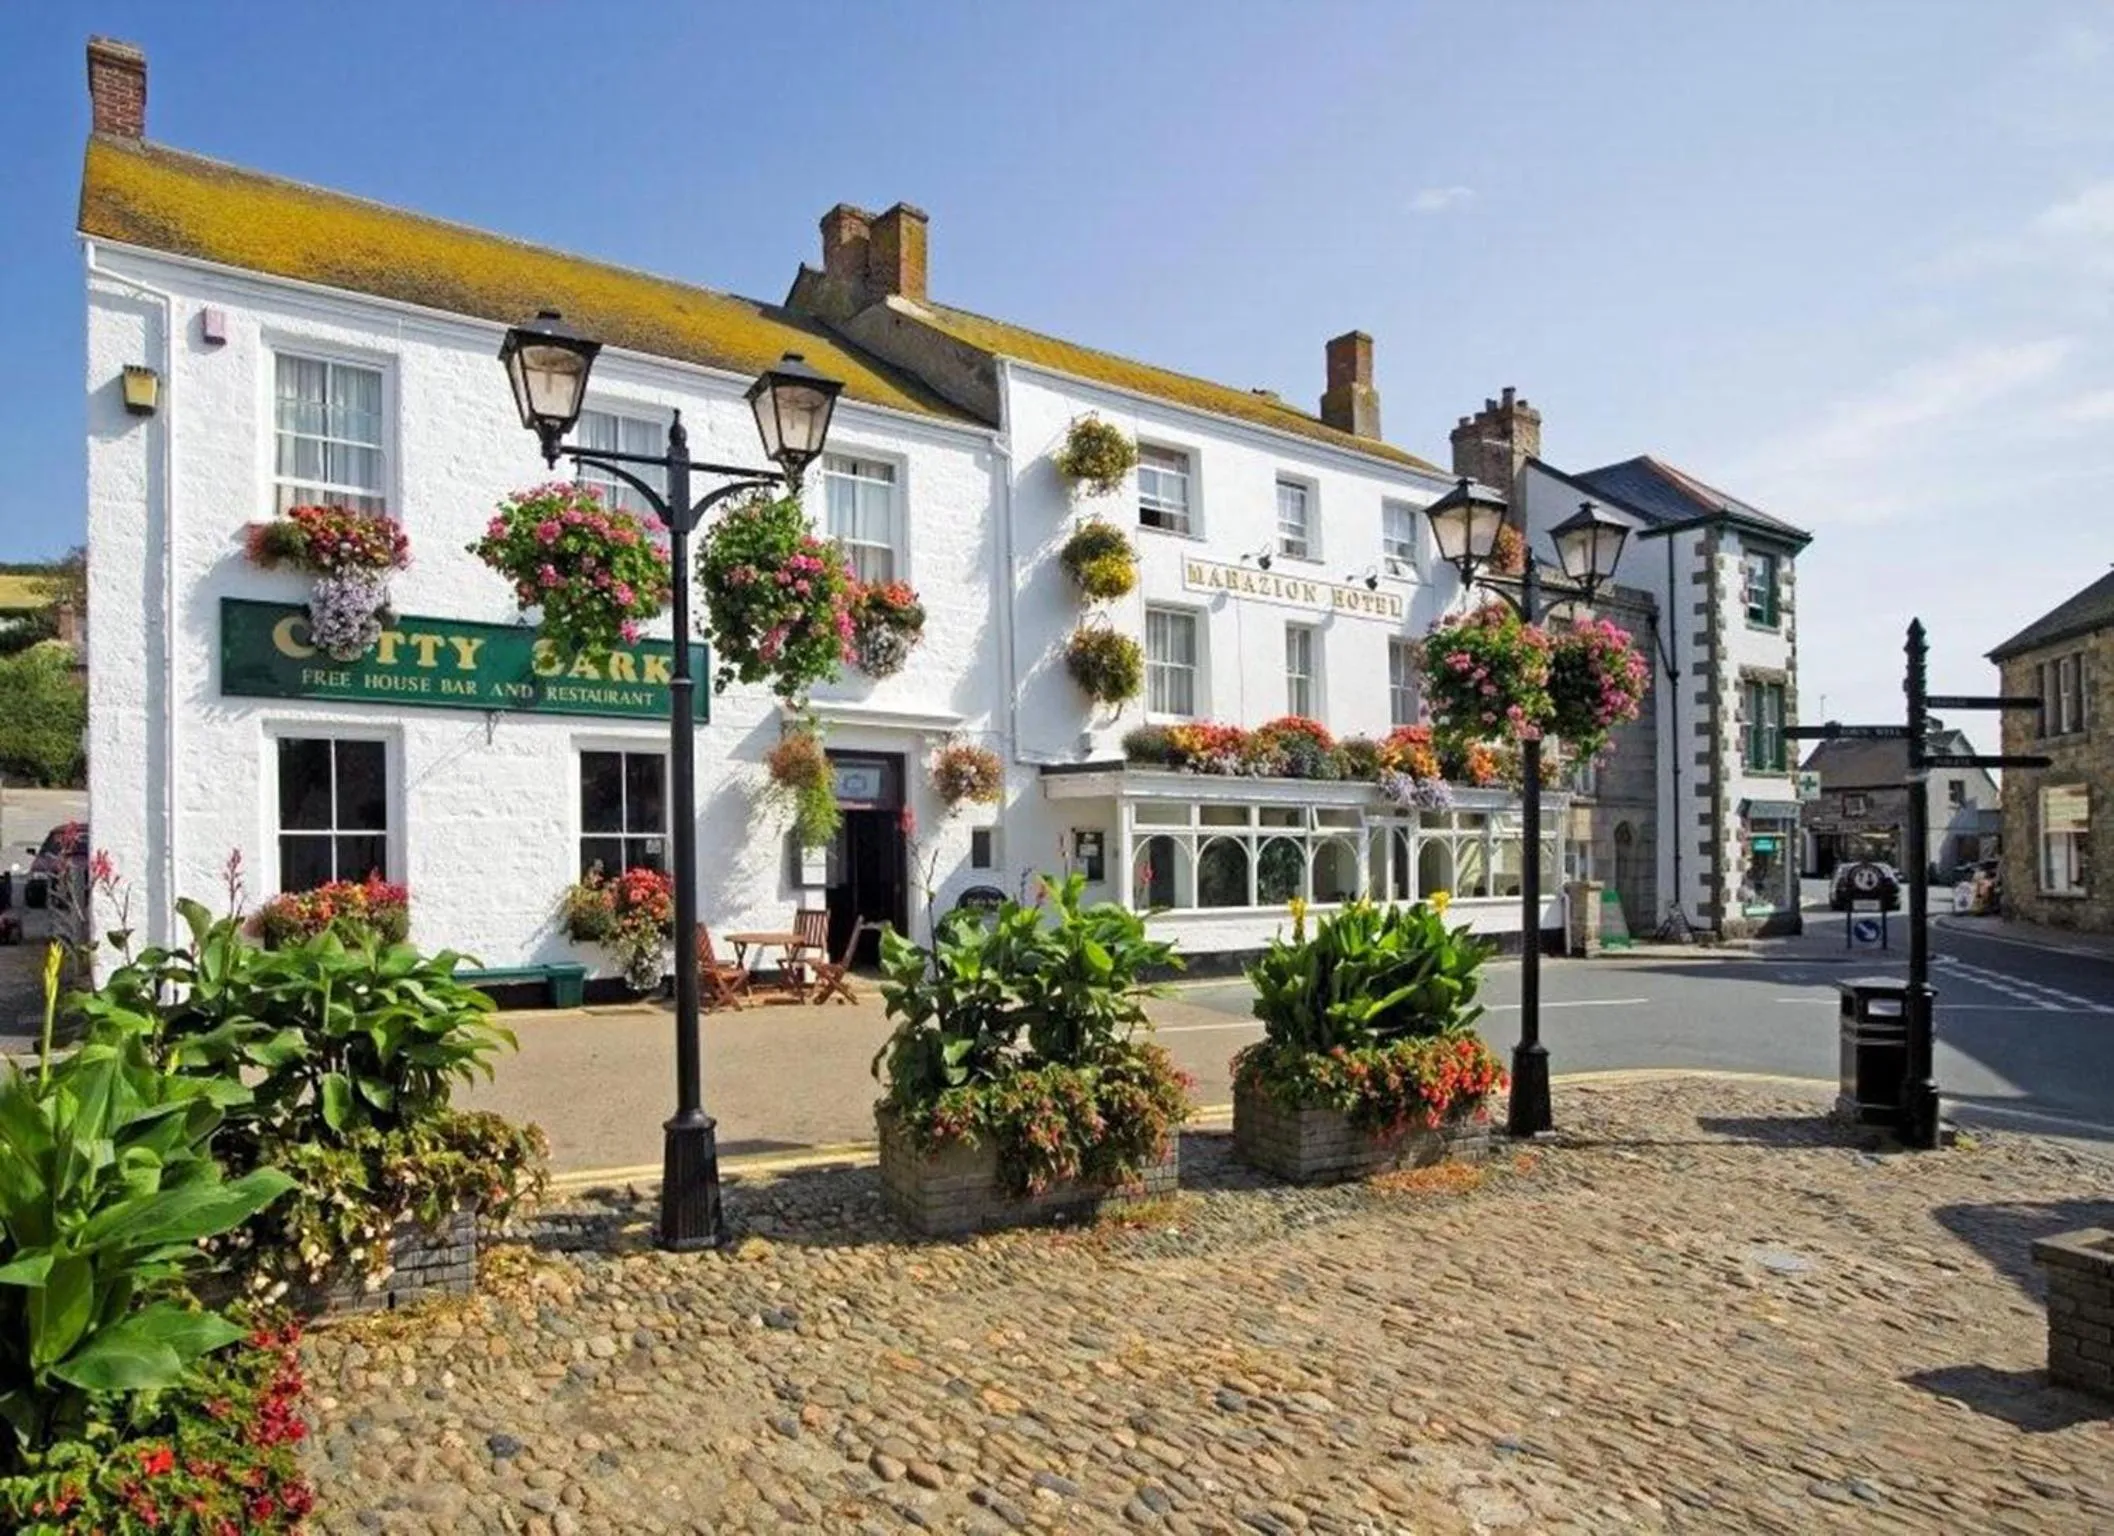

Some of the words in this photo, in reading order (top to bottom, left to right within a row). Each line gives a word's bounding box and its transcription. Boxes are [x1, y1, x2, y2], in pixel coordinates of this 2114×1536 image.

[1187, 563, 1317, 603] MARAZION
[1332, 586, 1401, 618] HOTEL
[272, 615, 486, 670] CTTY
[302, 668, 352, 687] FREE
[364, 673, 431, 693] HOUSE
[441, 678, 478, 695] BAR
[490, 682, 534, 699] AND
[546, 686, 656, 707] RESTAURANT
